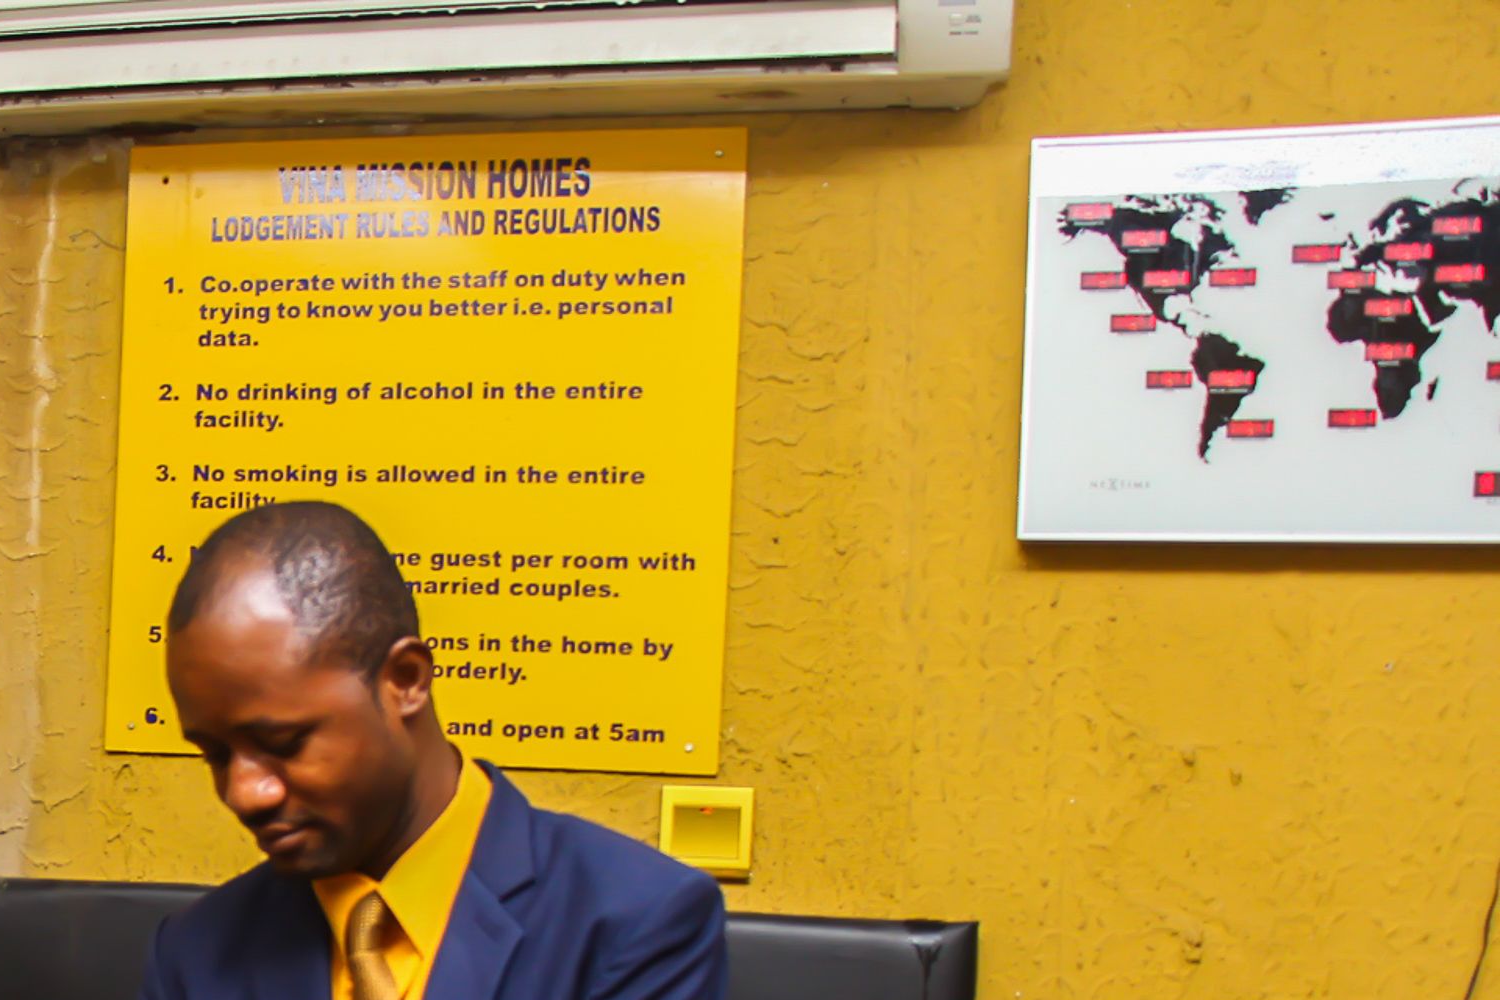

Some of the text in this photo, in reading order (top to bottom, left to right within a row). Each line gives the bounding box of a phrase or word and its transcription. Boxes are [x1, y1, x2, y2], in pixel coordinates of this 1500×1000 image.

[277, 154, 593, 204] VINA MISSION HOMES
[211, 206, 661, 243] LODGEMENT RULES AND REGULATIONS
[164, 268, 685, 297] 1. Co.operate with the staff on duty when
[199, 296, 673, 325] trying to know you better i.e. personal
[198, 329, 259, 347] data.
[158, 380, 643, 405] 2. No drinking of alcohol in the entire
[194, 410, 284, 432] facility.
[156, 464, 645, 487] 3. No smoking is allowed in the entire
[151, 544, 173, 563] 4.
[430, 550, 502, 572] guest
[511, 554, 554, 572] per
[562, 555, 629, 570] room
[638, 552, 696, 571] with
[403, 576, 619, 602] married couples.
[478, 633, 501, 653] in
[510, 634, 552, 653] the
[562, 635, 633, 656] home
[643, 638, 674, 661] by
[431, 661, 527, 686] orderly.
[144, 707, 165, 725] 6.
[446, 719, 665, 743] and open at 5am
